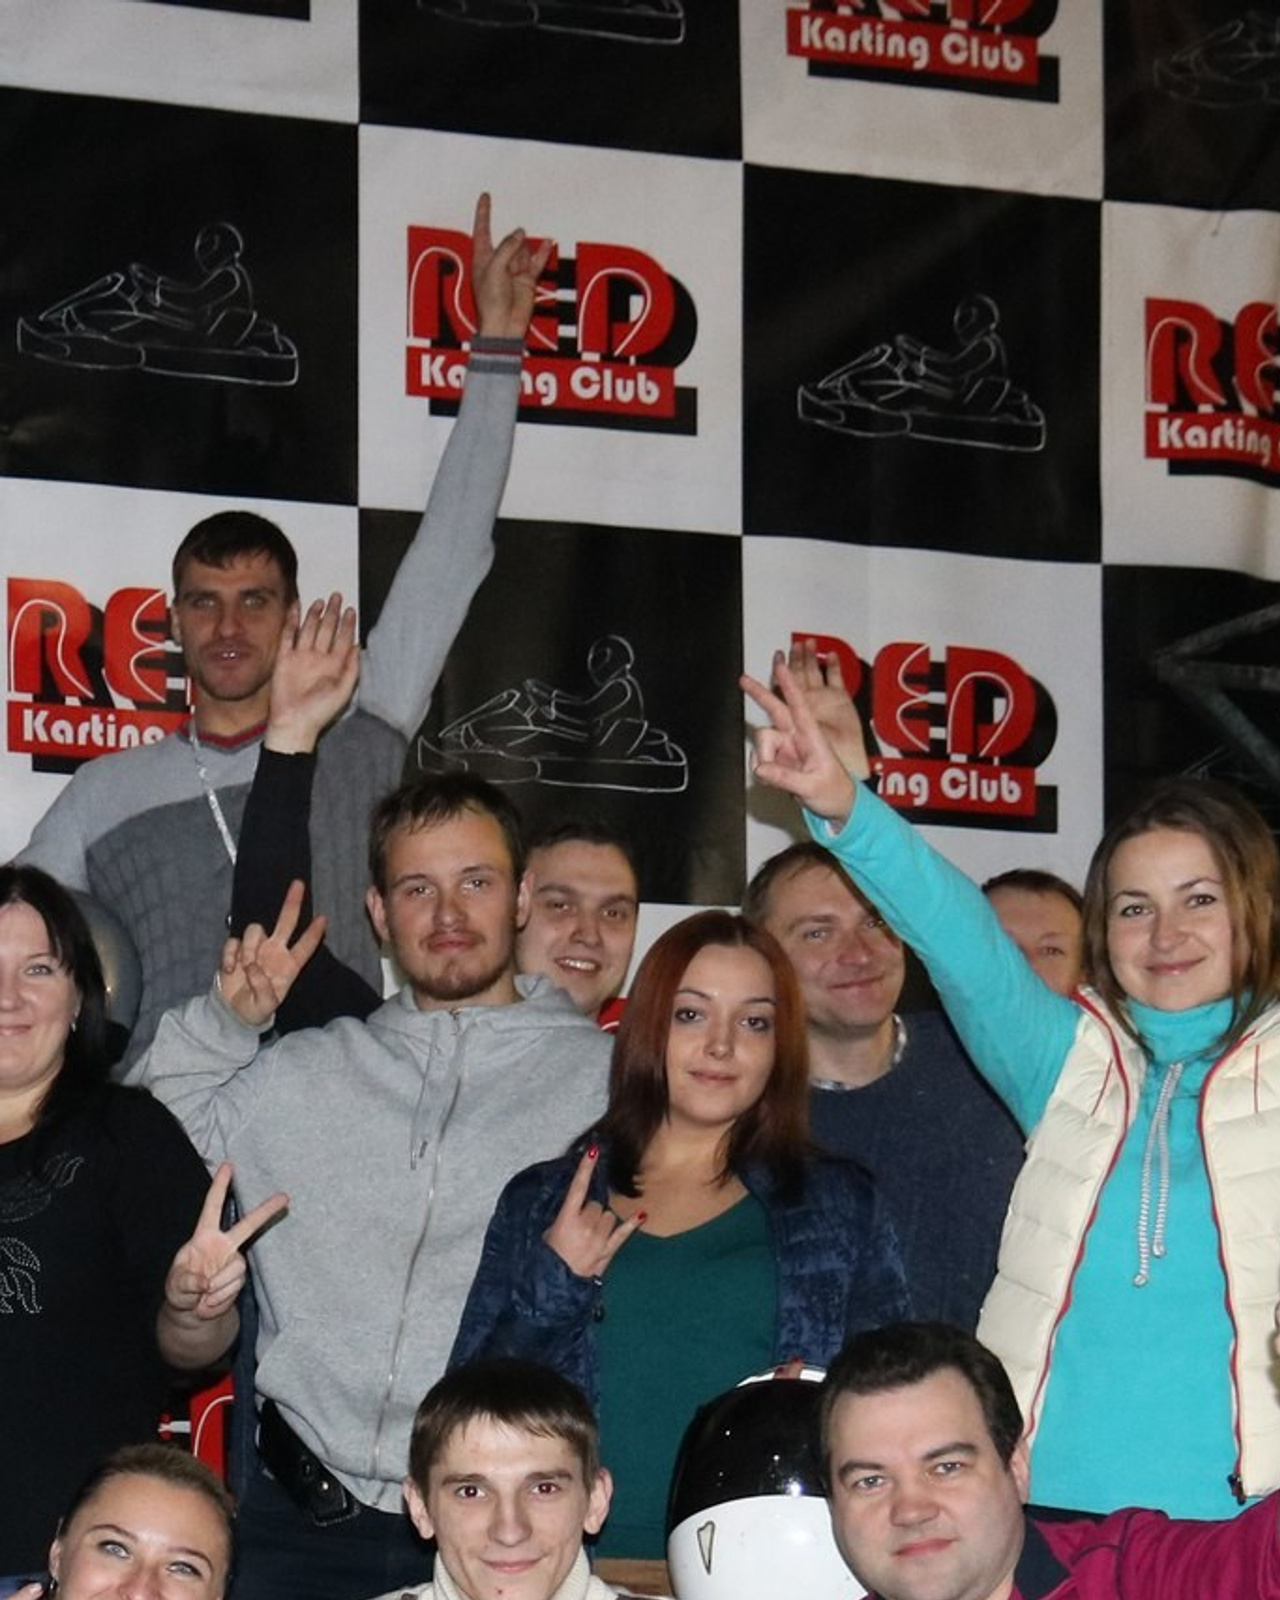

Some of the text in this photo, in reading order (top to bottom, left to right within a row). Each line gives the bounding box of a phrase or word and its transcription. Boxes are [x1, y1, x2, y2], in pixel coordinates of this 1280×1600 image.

[800, 15, 1024, 72] Karting Club
[420, 354, 660, 406] Kang Club
[1158, 418, 1272, 466] Karting
[8, 578, 196, 705] RE
[940, 767, 1021, 803] Club
